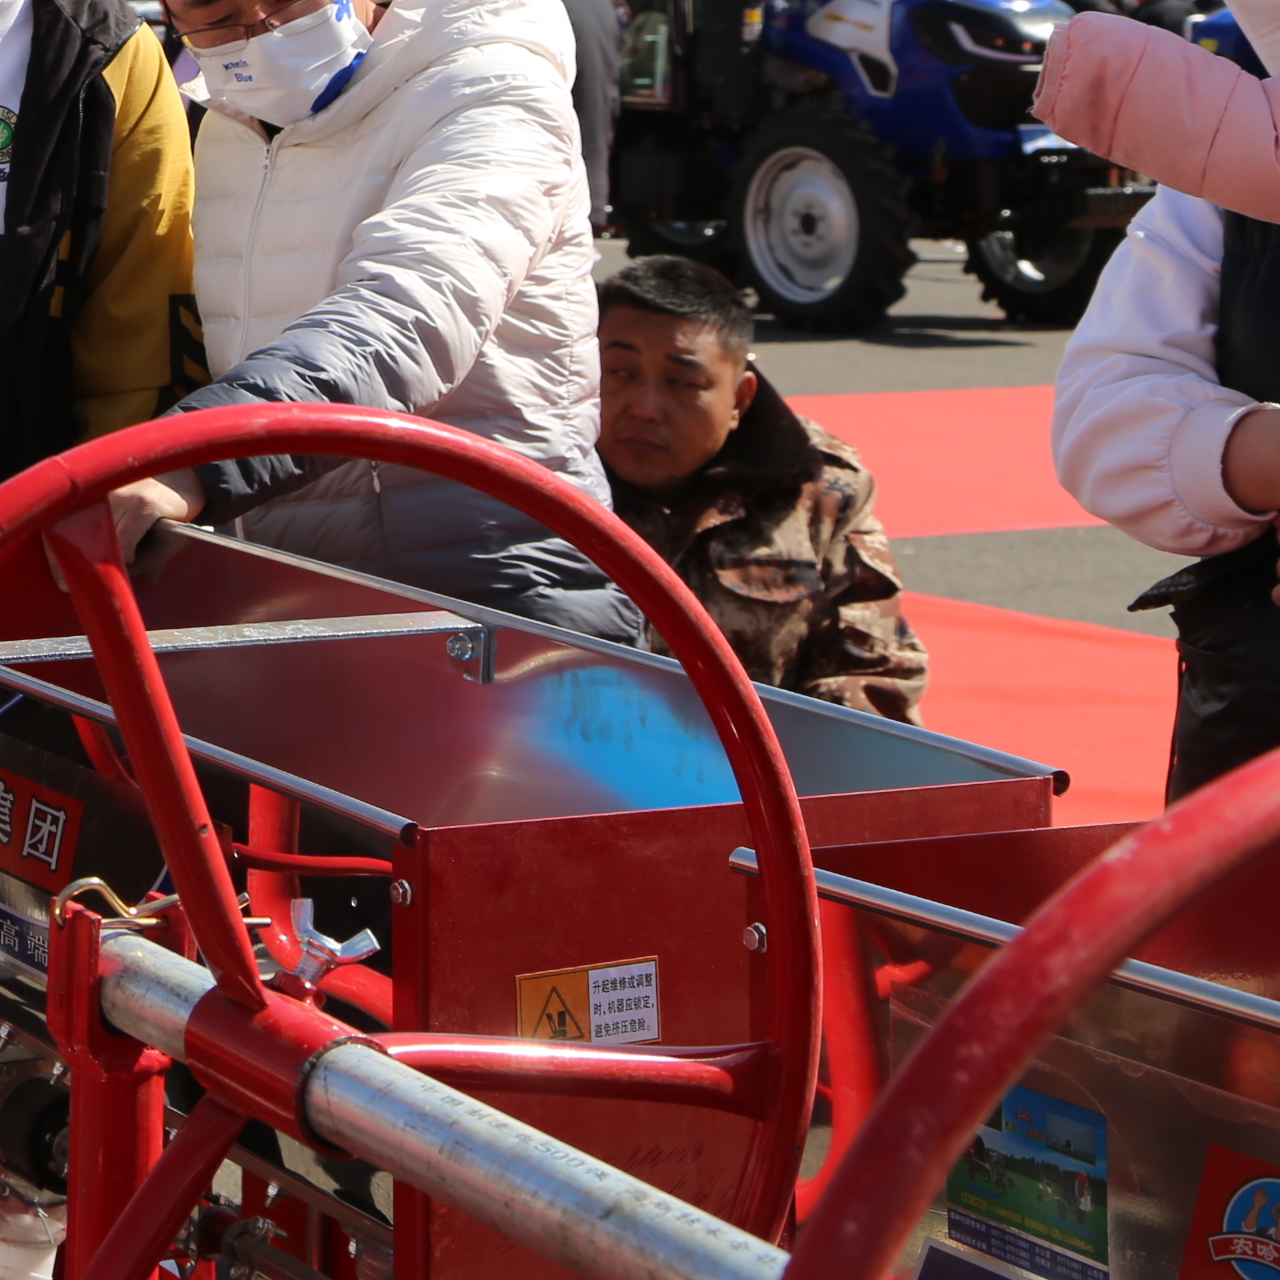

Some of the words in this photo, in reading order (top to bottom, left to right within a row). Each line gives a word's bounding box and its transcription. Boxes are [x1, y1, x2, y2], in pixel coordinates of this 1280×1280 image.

[234, 72, 254, 83] Blue
[592, 972, 654, 995] 升起维修或调整
